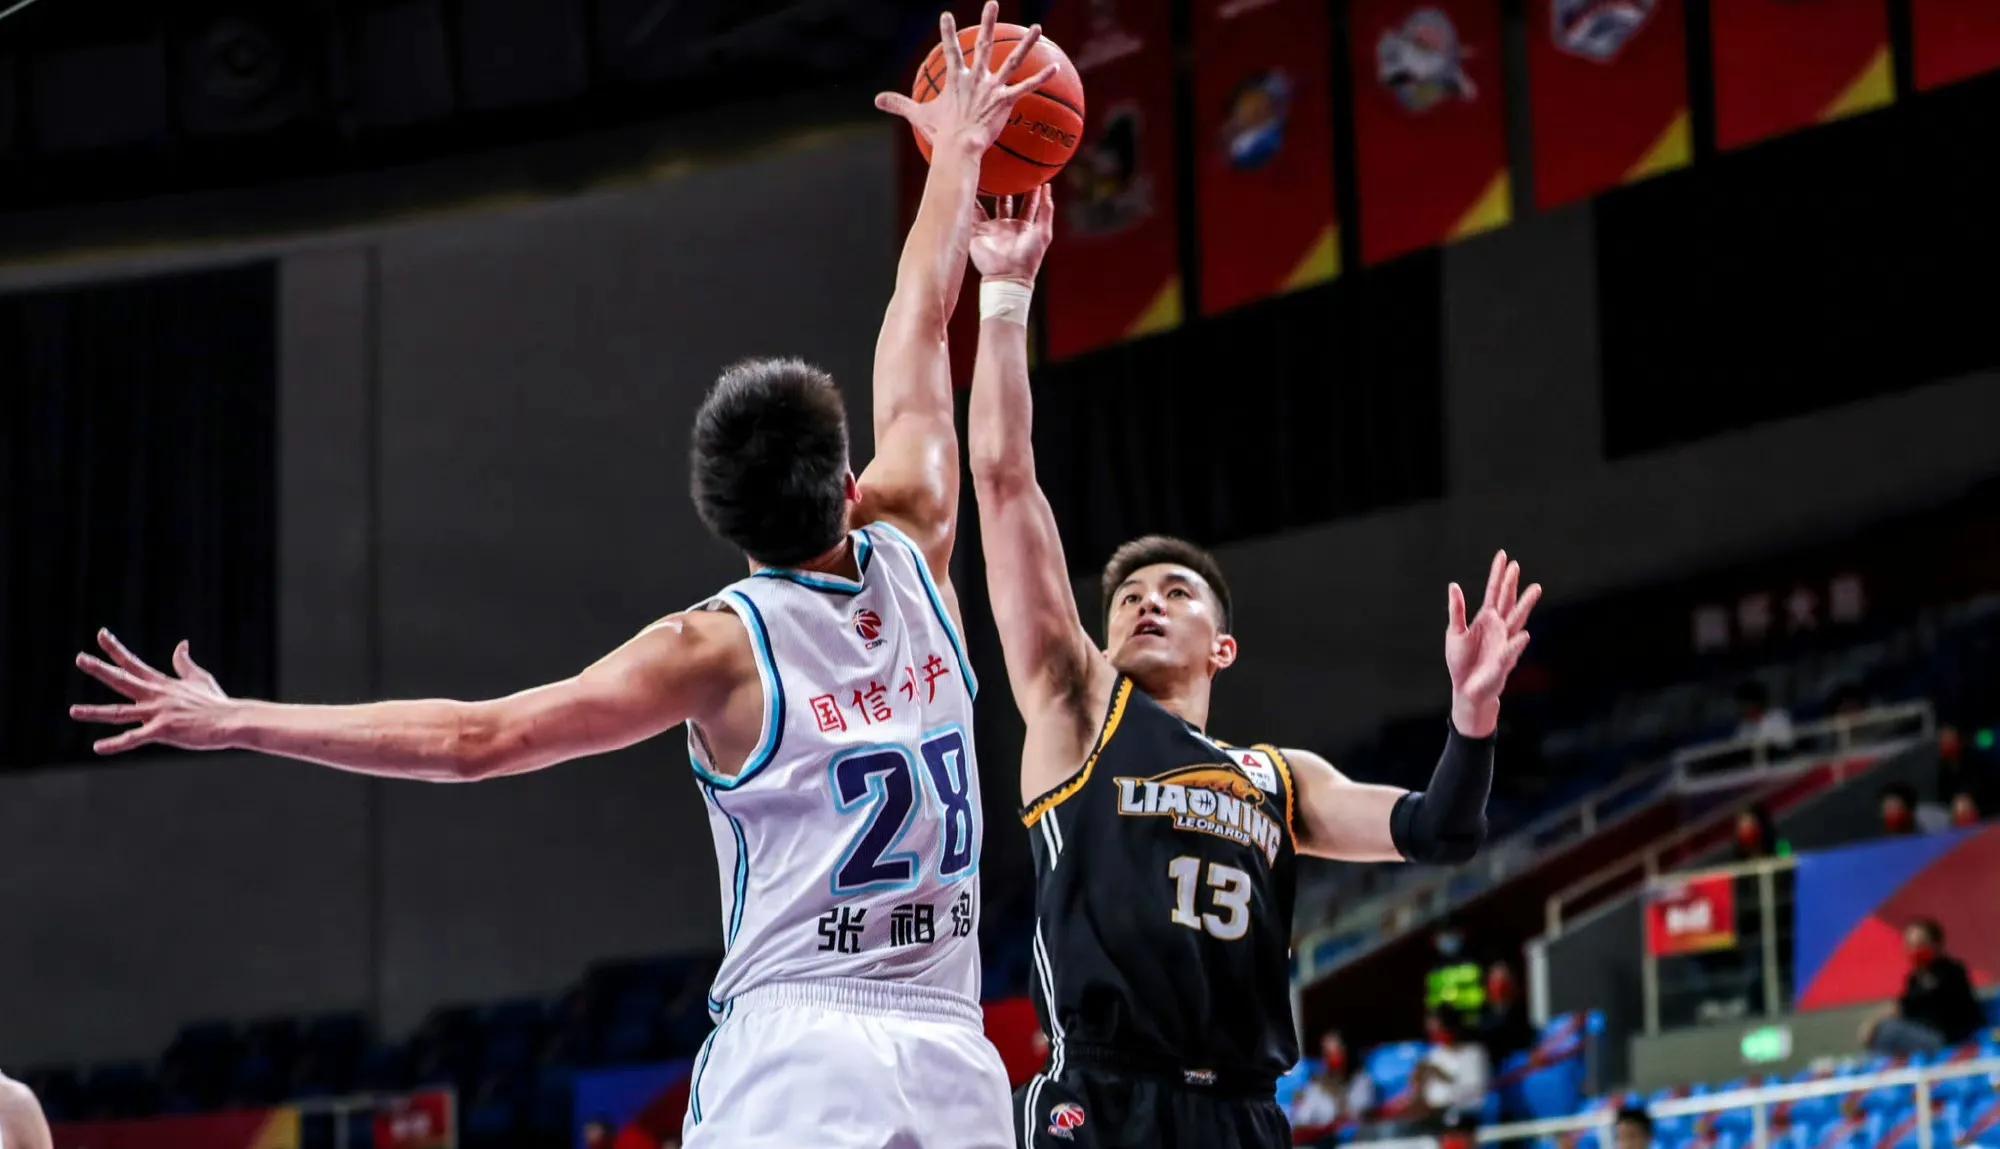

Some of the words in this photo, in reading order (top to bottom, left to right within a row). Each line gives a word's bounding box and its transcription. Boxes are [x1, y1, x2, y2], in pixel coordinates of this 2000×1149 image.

[1007, 113, 1076, 148] I-NING
[829, 721, 979, 896] 28
[1117, 777, 1283, 867] LIAONING
[1177, 814, 1251, 843] LEOPARDS
[1168, 855, 1252, 941] 13
